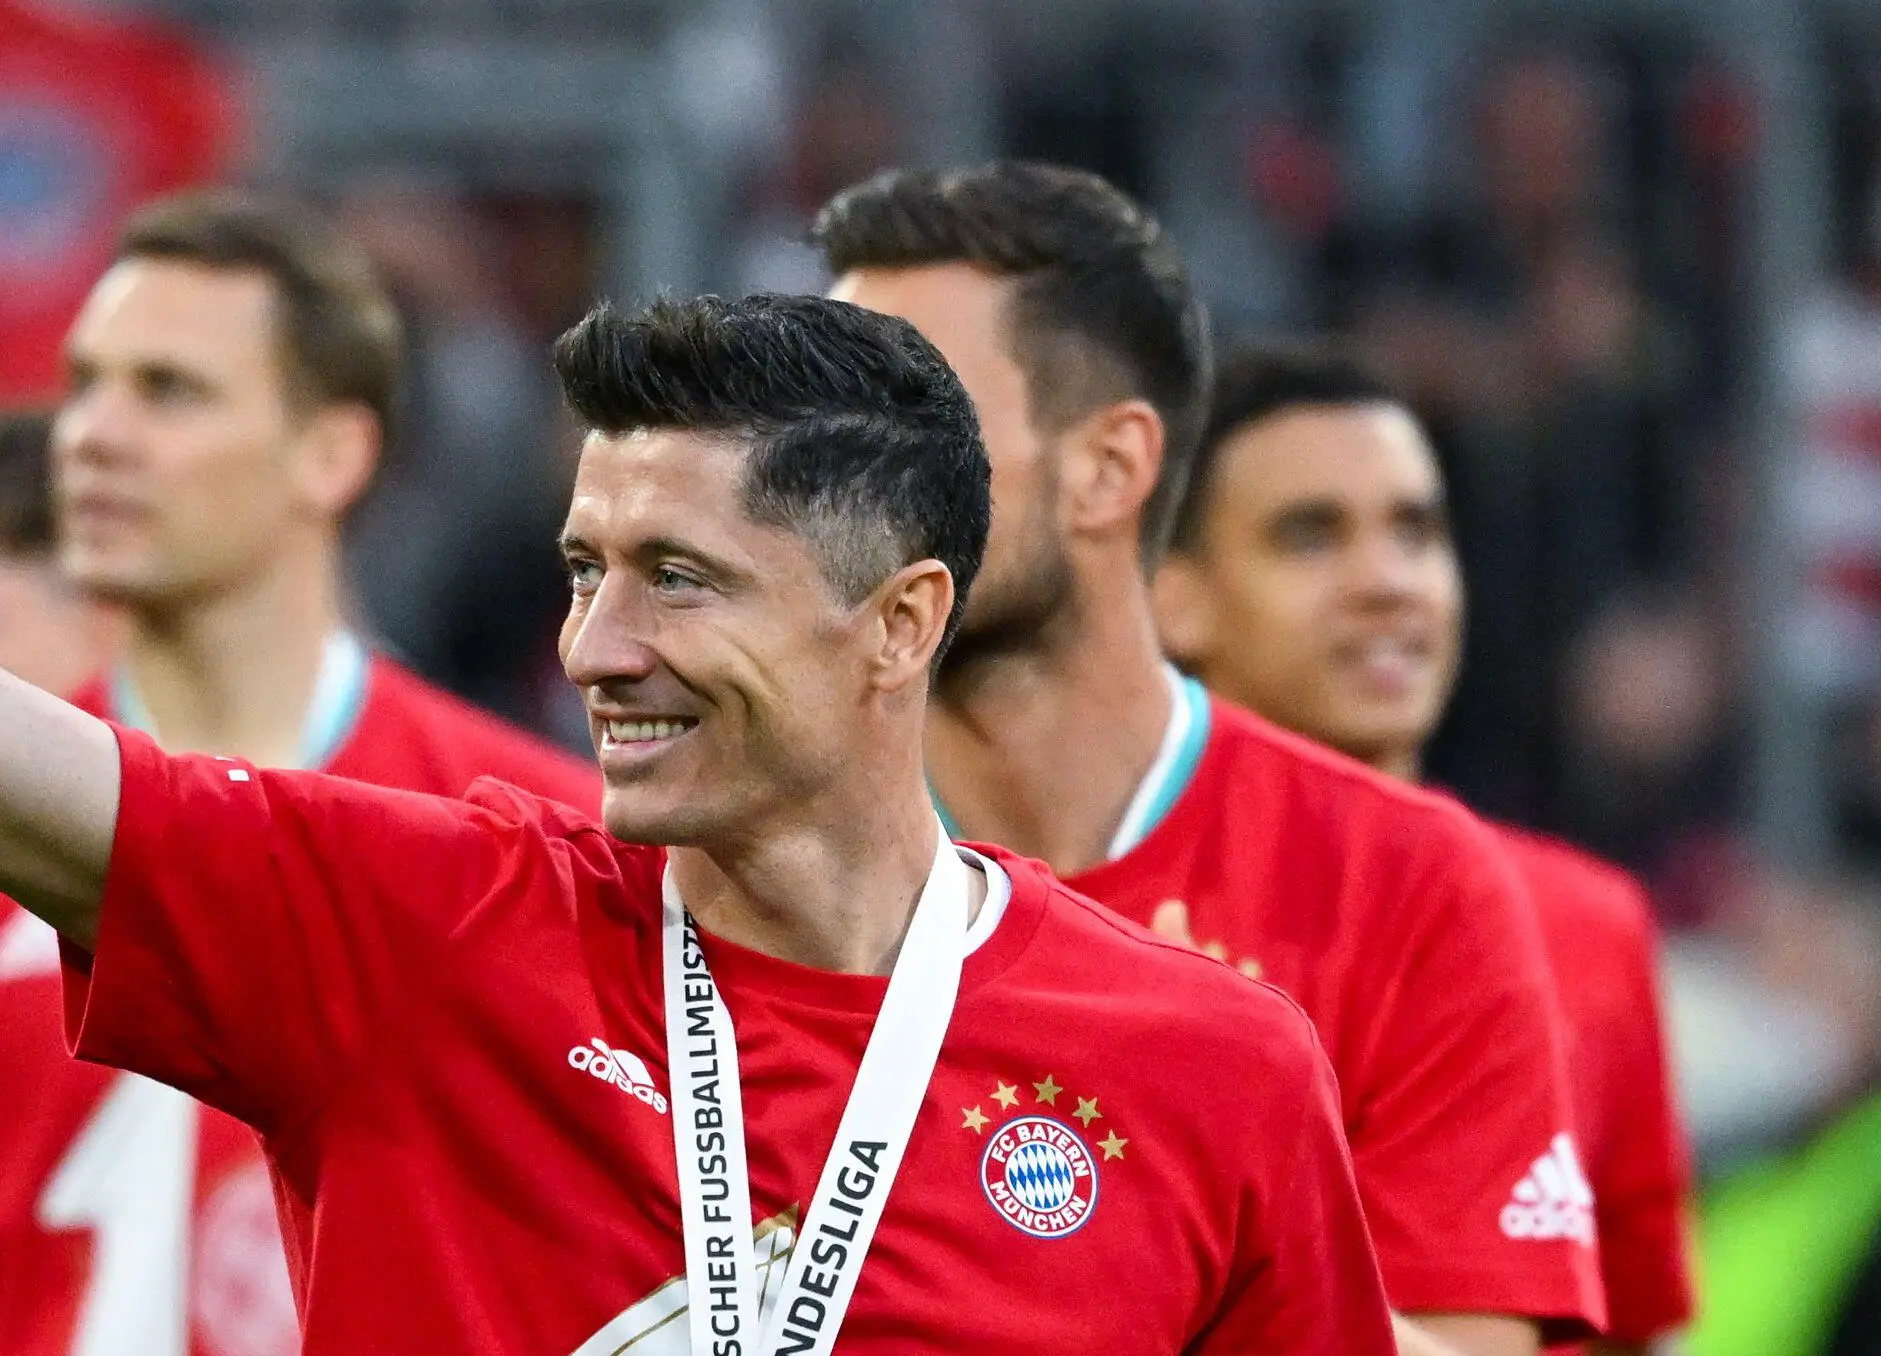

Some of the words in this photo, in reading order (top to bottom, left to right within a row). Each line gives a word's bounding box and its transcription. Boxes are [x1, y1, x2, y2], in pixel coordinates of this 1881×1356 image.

[567, 1037, 668, 1114] adidas
[683, 903, 732, 1223] FUSSBALLMEISTE
[991, 1134, 1016, 1164] FC
[1016, 1124, 1090, 1177] BAYERN
